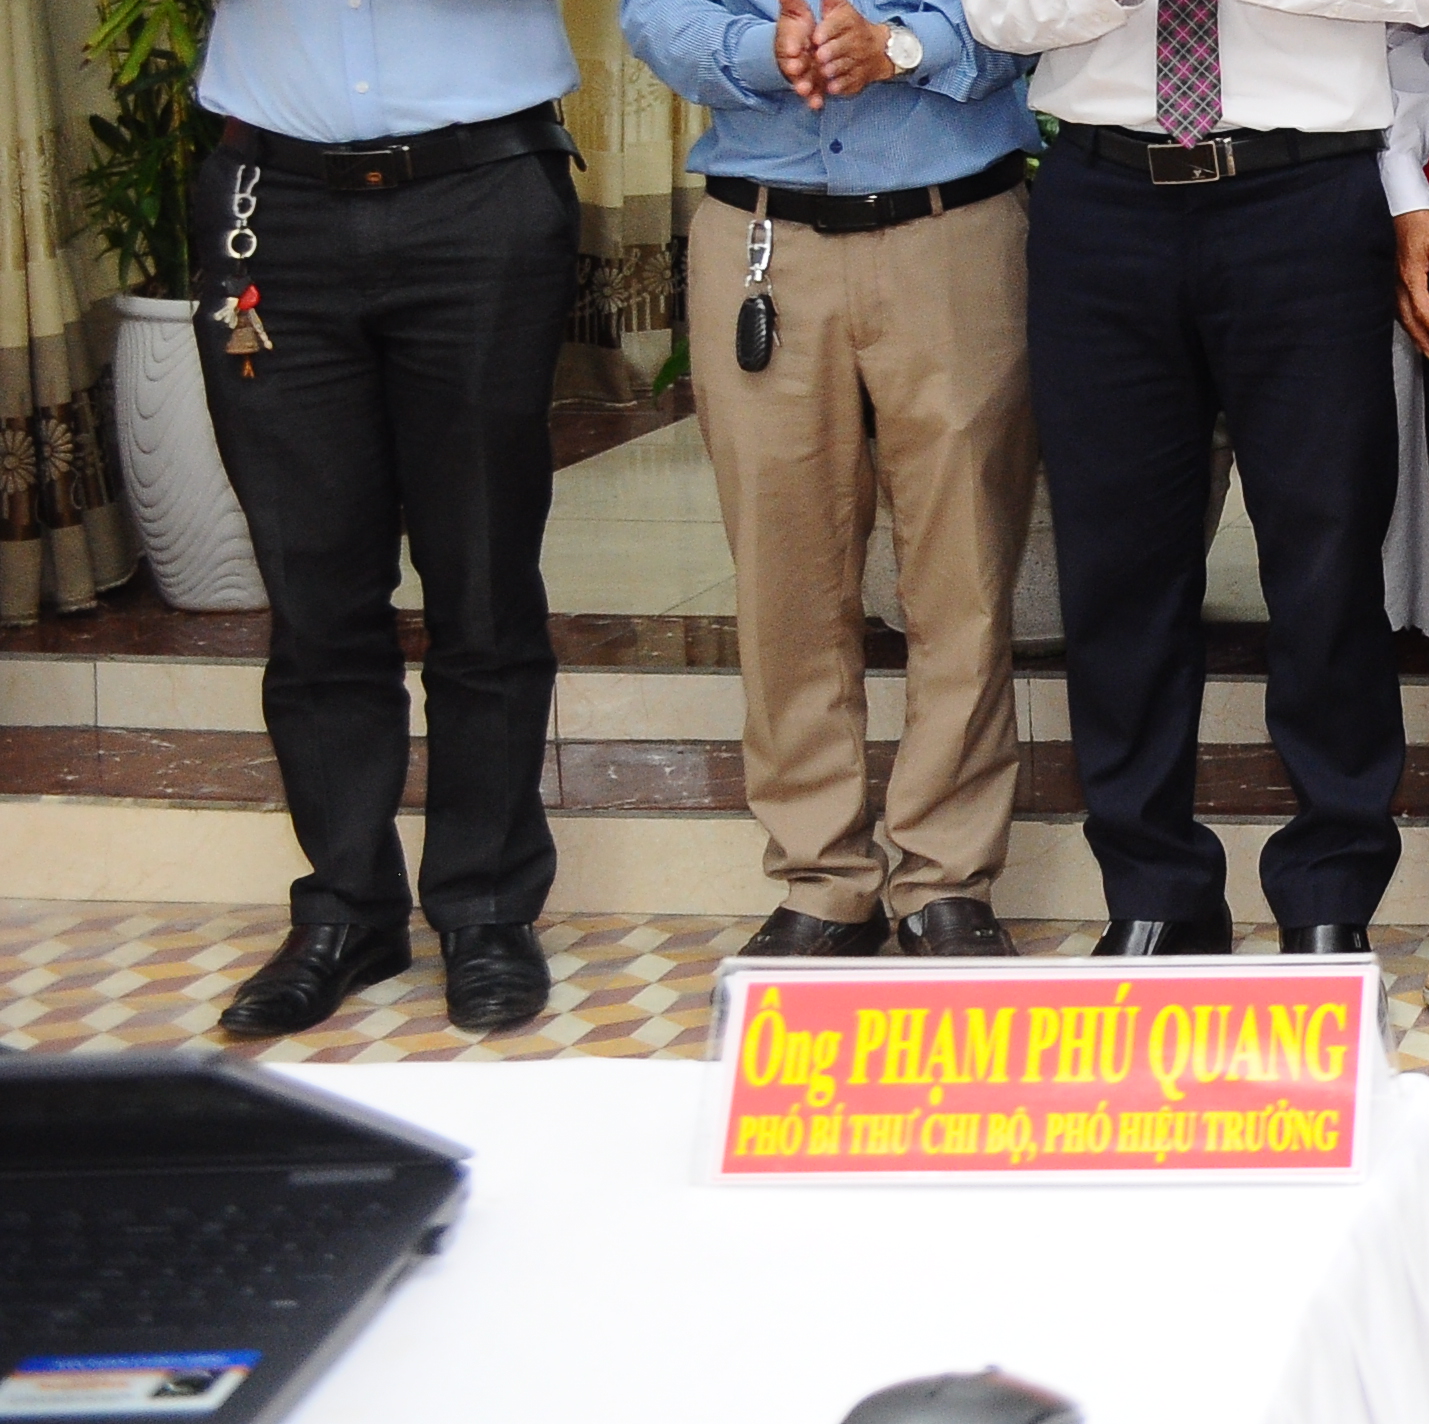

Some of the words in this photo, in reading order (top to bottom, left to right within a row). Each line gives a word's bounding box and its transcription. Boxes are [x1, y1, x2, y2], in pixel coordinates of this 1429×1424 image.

[742, 985, 843, 1108] Ông
[847, 1006, 1018, 1107] PHẠM
[1021, 982, 1142, 1084] PHÚ
[1147, 1003, 1348, 1102] QUANG
[733, 1102, 804, 1157] PHÓ
[807, 1102, 846, 1156] BÍ
[848, 1107, 922, 1156] THƯ
[920, 1112, 982, 1155] CHI
[984, 1106, 1038, 1165] BỘ,
[1043, 1100, 1113, 1154] PHÓ
[1115, 1105, 1198, 1164] HIỆU
